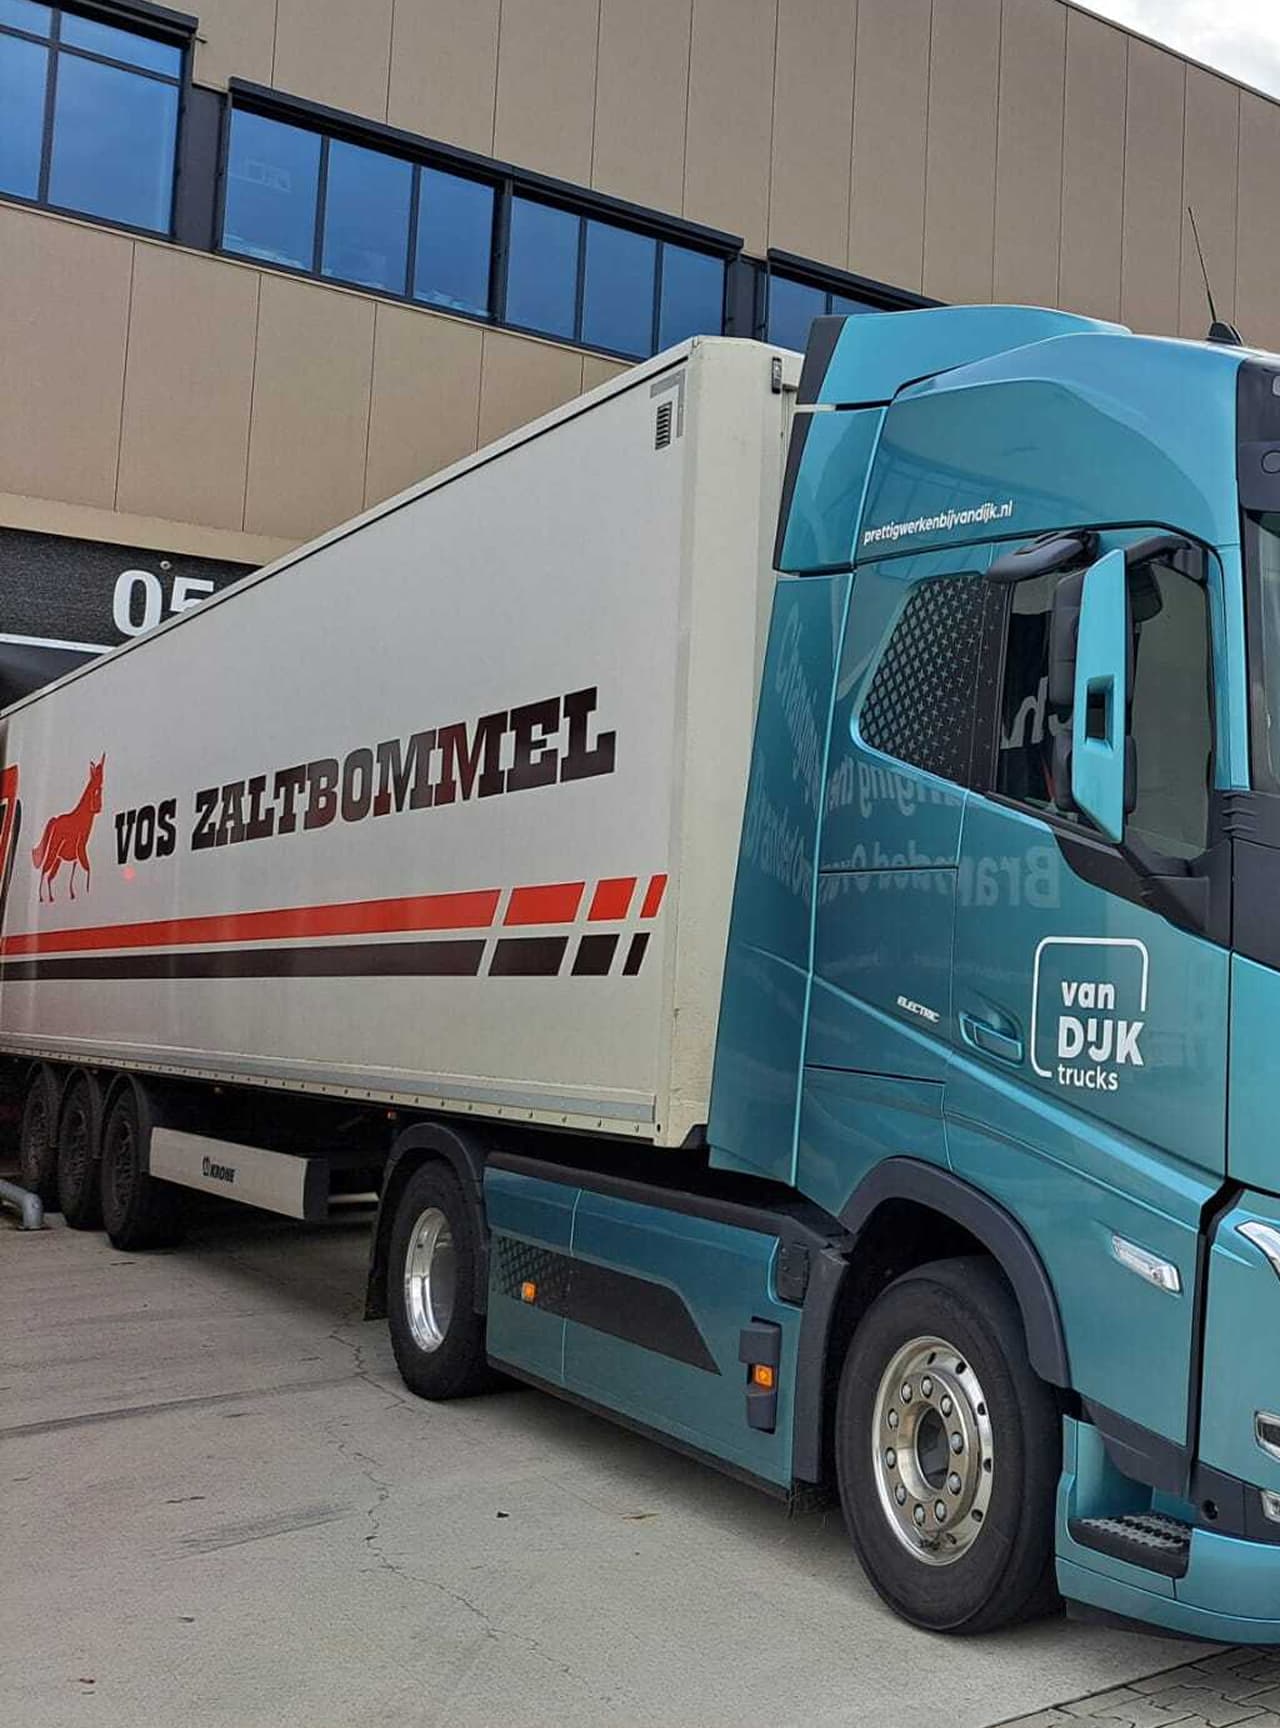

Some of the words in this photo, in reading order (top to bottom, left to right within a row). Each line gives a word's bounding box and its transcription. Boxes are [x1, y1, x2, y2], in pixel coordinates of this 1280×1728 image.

[863, 500, 1014, 546] prettigwerkenbijvandijk.nl
[115, 798, 177, 865] VOS
[191, 685, 617, 851] ZALTBOMMEL
[897, 995, 941, 1024] ELECTRIC
[1061, 980, 1116, 1010] van
[1058, 1063, 1119, 1091] trucks
